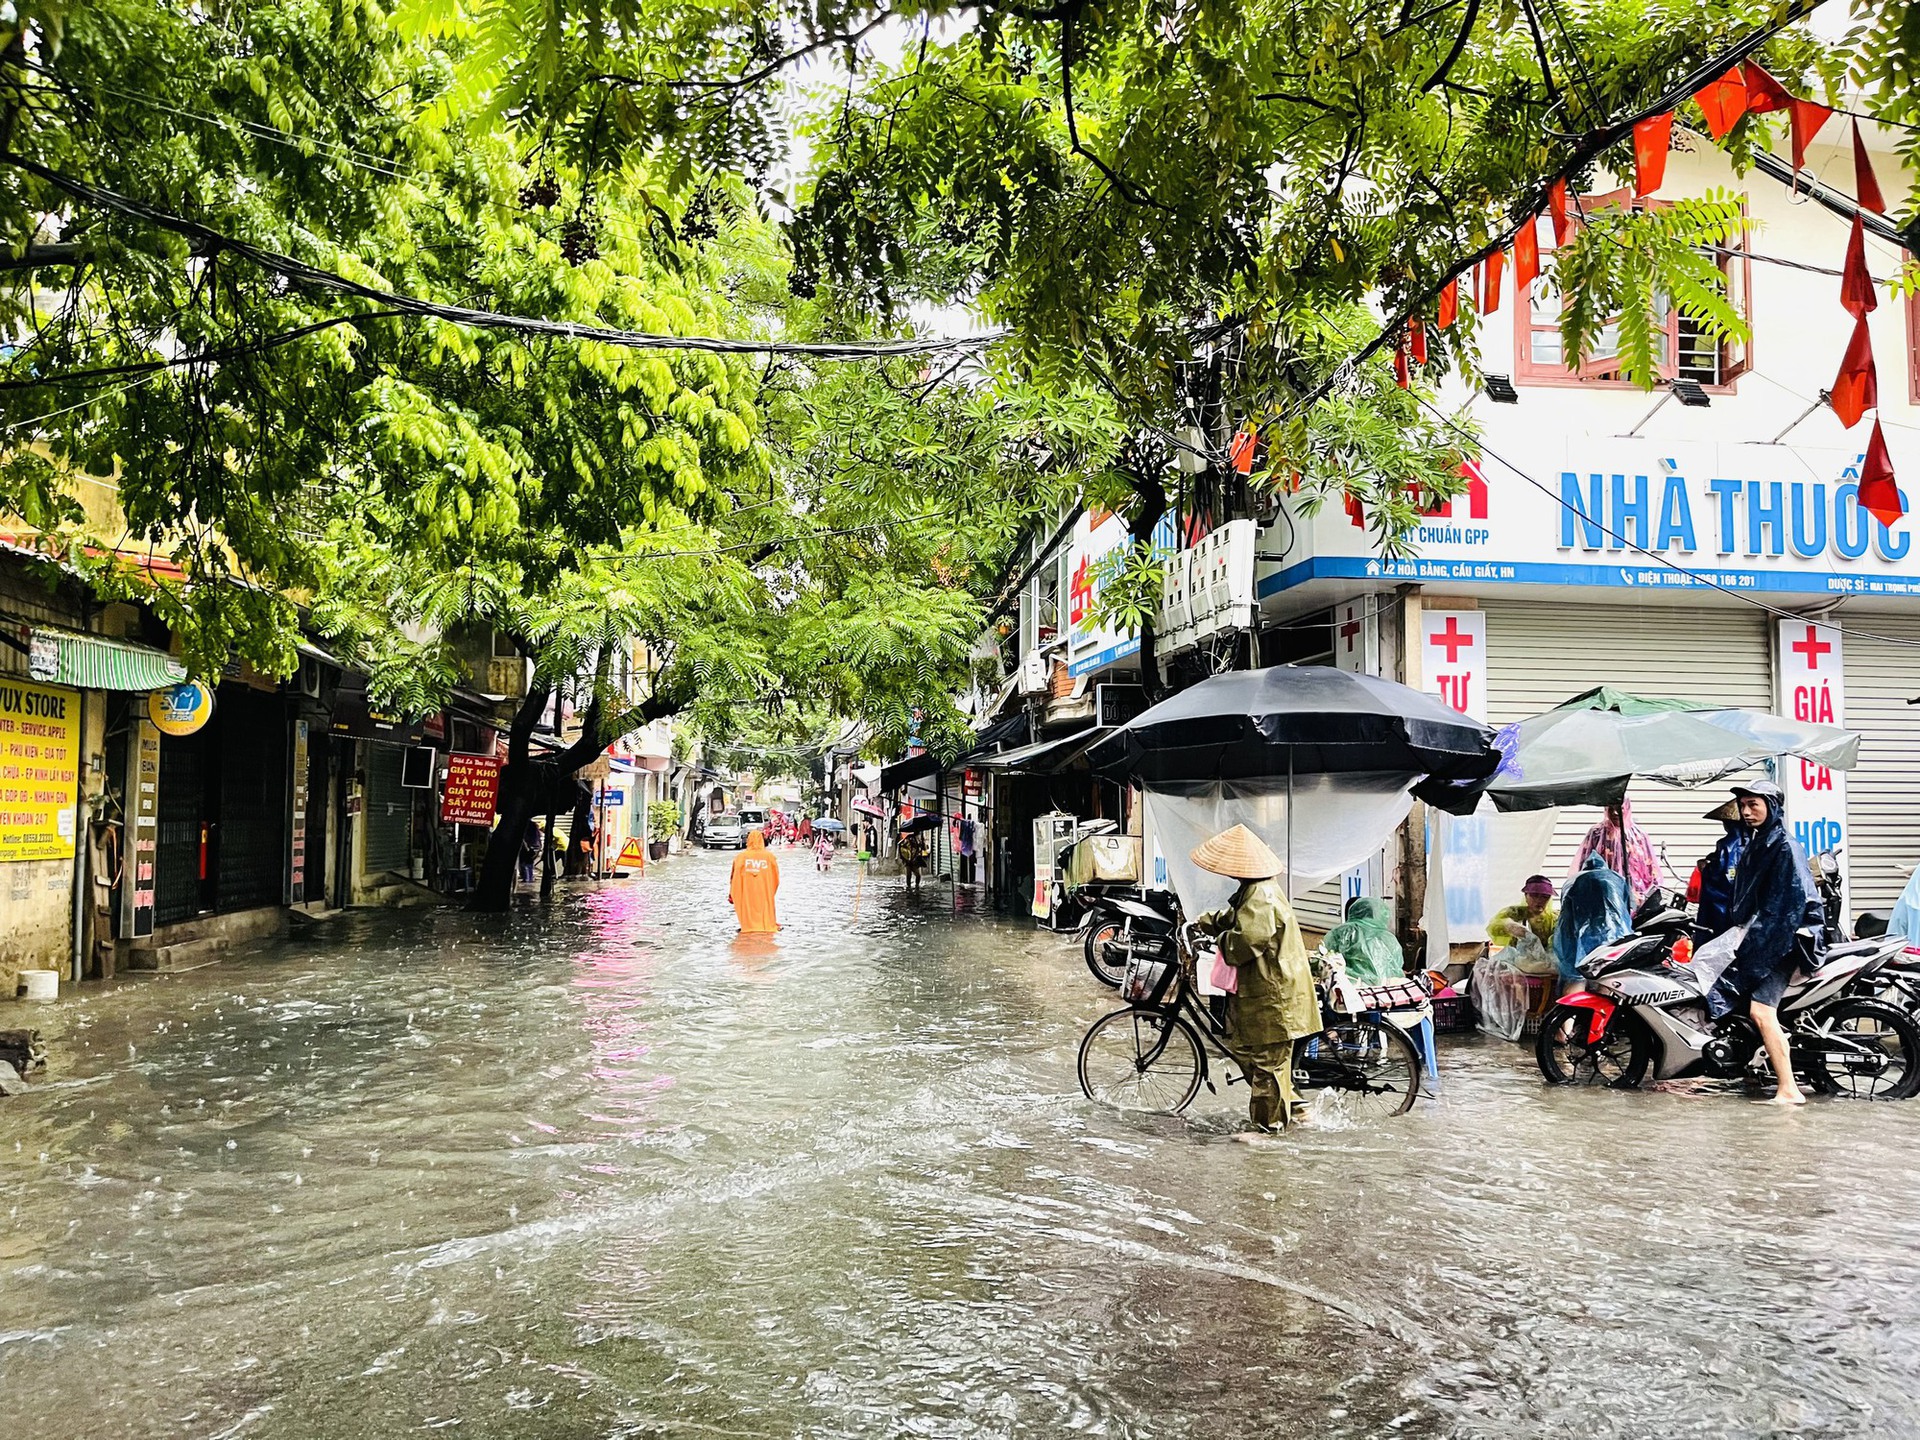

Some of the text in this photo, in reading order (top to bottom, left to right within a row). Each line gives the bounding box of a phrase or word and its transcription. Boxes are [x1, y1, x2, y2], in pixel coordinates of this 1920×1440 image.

[1559, 453, 1911, 562] NHÀ THUỐC
[1418, 521, 1461, 544] CHUẨN
[1465, 528, 1490, 545] GPP
[1500, 566, 1515, 578] HN
[1638, 571, 1660, 586] ĐIỆN
[1720, 574, 1737, 586] 166
[1738, 575, 1755, 587] 201
[1436, 671, 1471, 713] TƯ
[25, 691, 66, 719] STORE
[1794, 678, 1834, 724] GIÁ
[164, 713, 195, 722] STORE
[21, 722, 46, 737] SERVICE
[47, 725, 66, 739] APPLE
[455, 776, 468, 785] LÀ
[476, 769, 497, 778] KHÔ
[471, 801, 492, 810] KHÔ
[467, 810, 487, 818] NGAY
[1626, 989, 1686, 1006] WINNER
